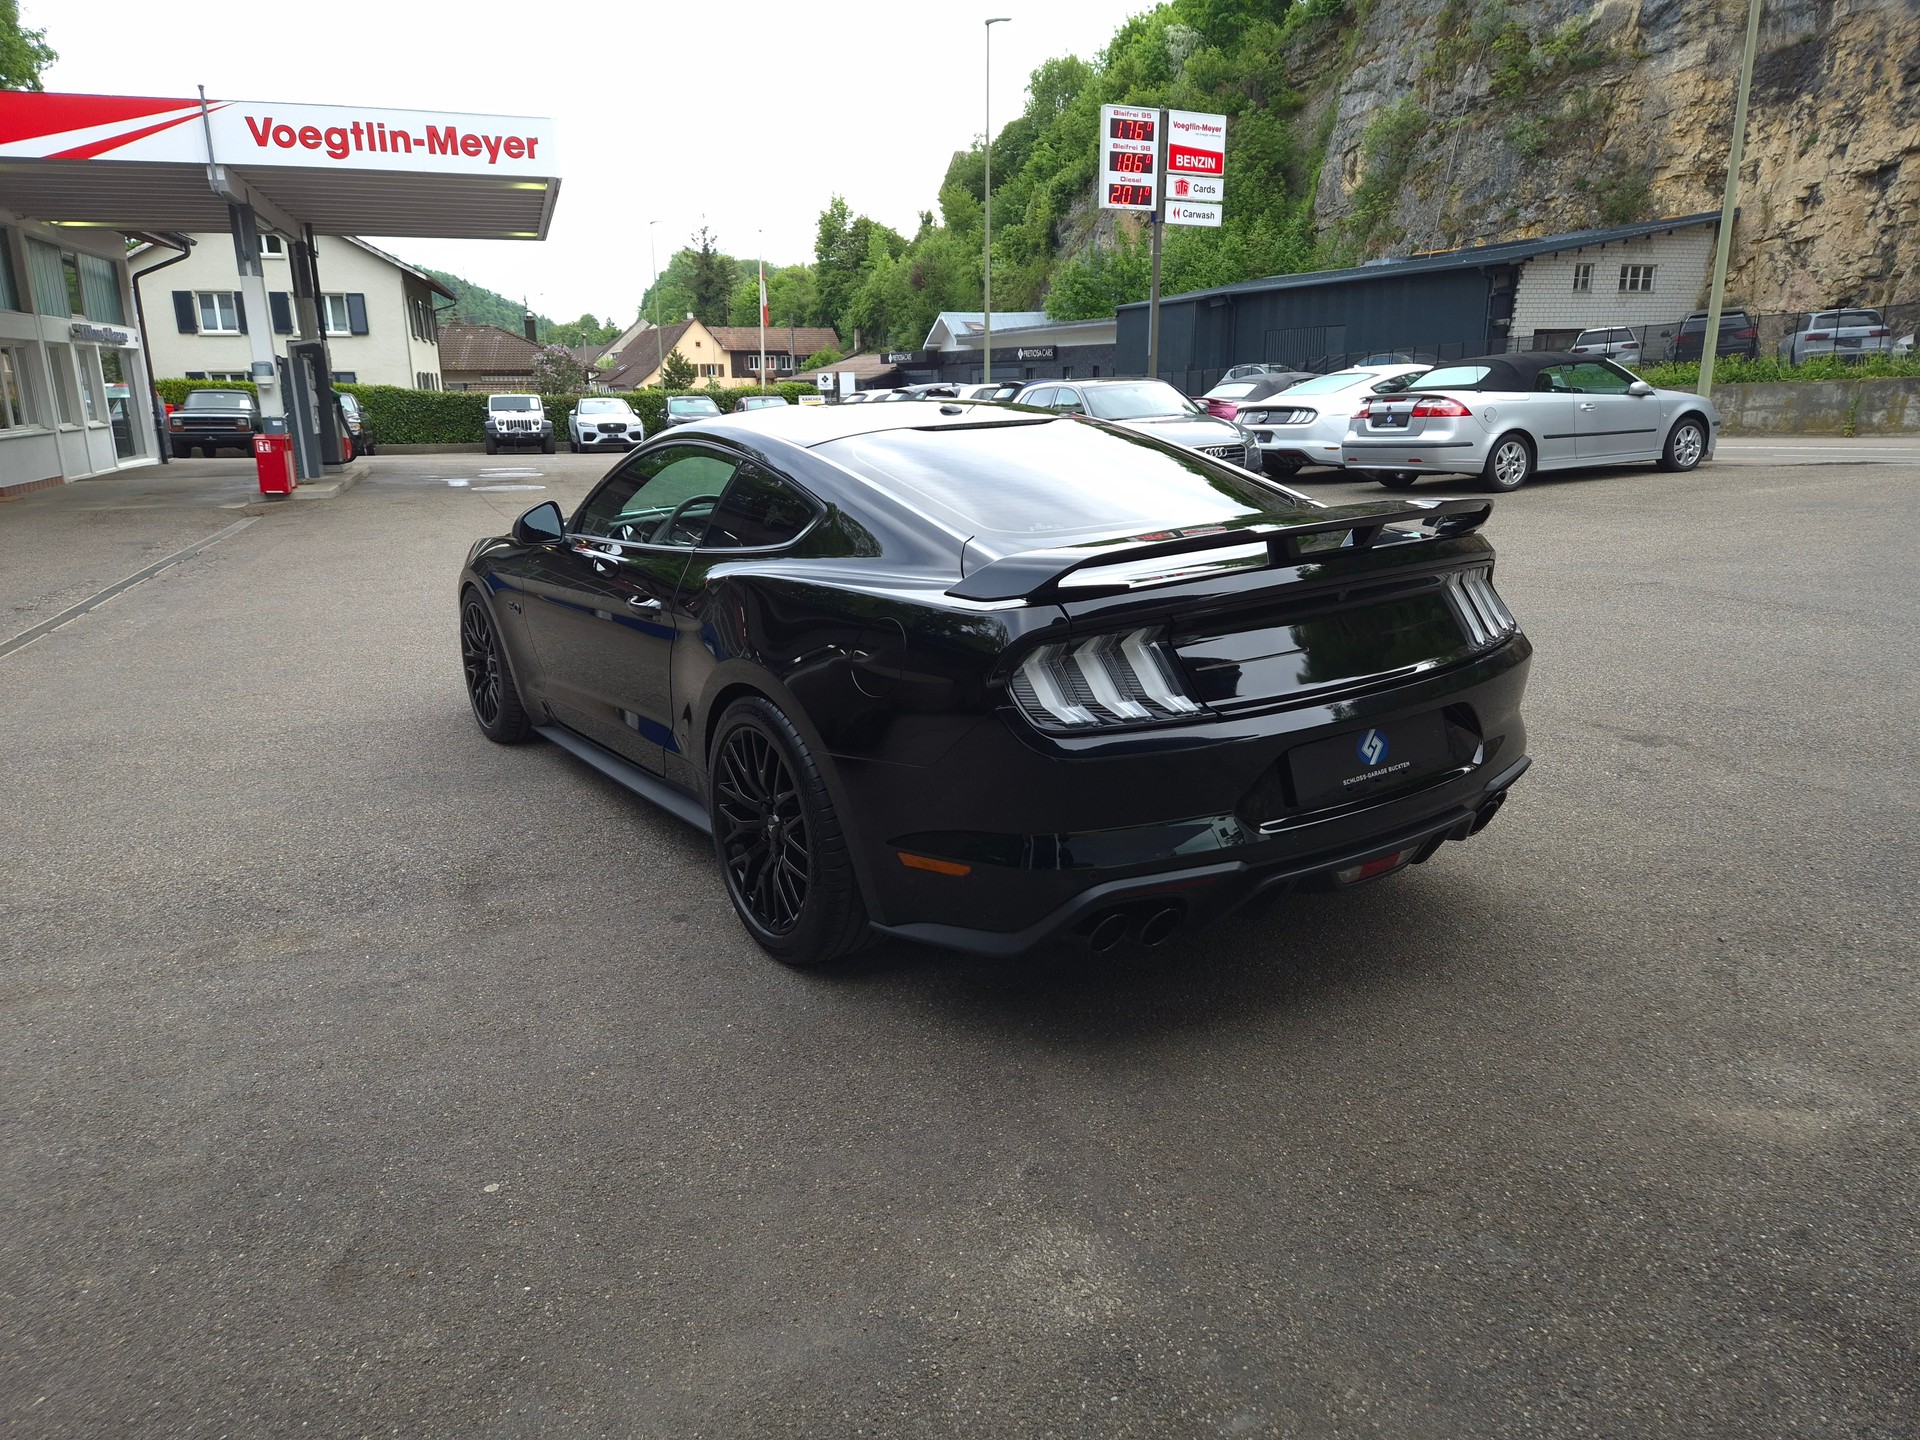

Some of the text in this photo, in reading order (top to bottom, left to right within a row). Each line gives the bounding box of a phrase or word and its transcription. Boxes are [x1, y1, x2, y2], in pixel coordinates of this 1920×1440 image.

[1113, 109, 1139, 118] Bleifrei
[1173, 120, 1222, 133] Voegtlin-Meyer
[244, 116, 539, 164] Voegtlin-Meyer
[1112, 142, 1151, 152] Bleifrei 98
[1175, 154, 1216, 169] BENZIN
[1120, 176, 1142, 184] Diesel
[1193, 183, 1216, 194] Cards
[1182, 209, 1215, 220] Carwash
[1342, 761, 1411, 786] SCHLOSS-GARAGE BUCKTEN
